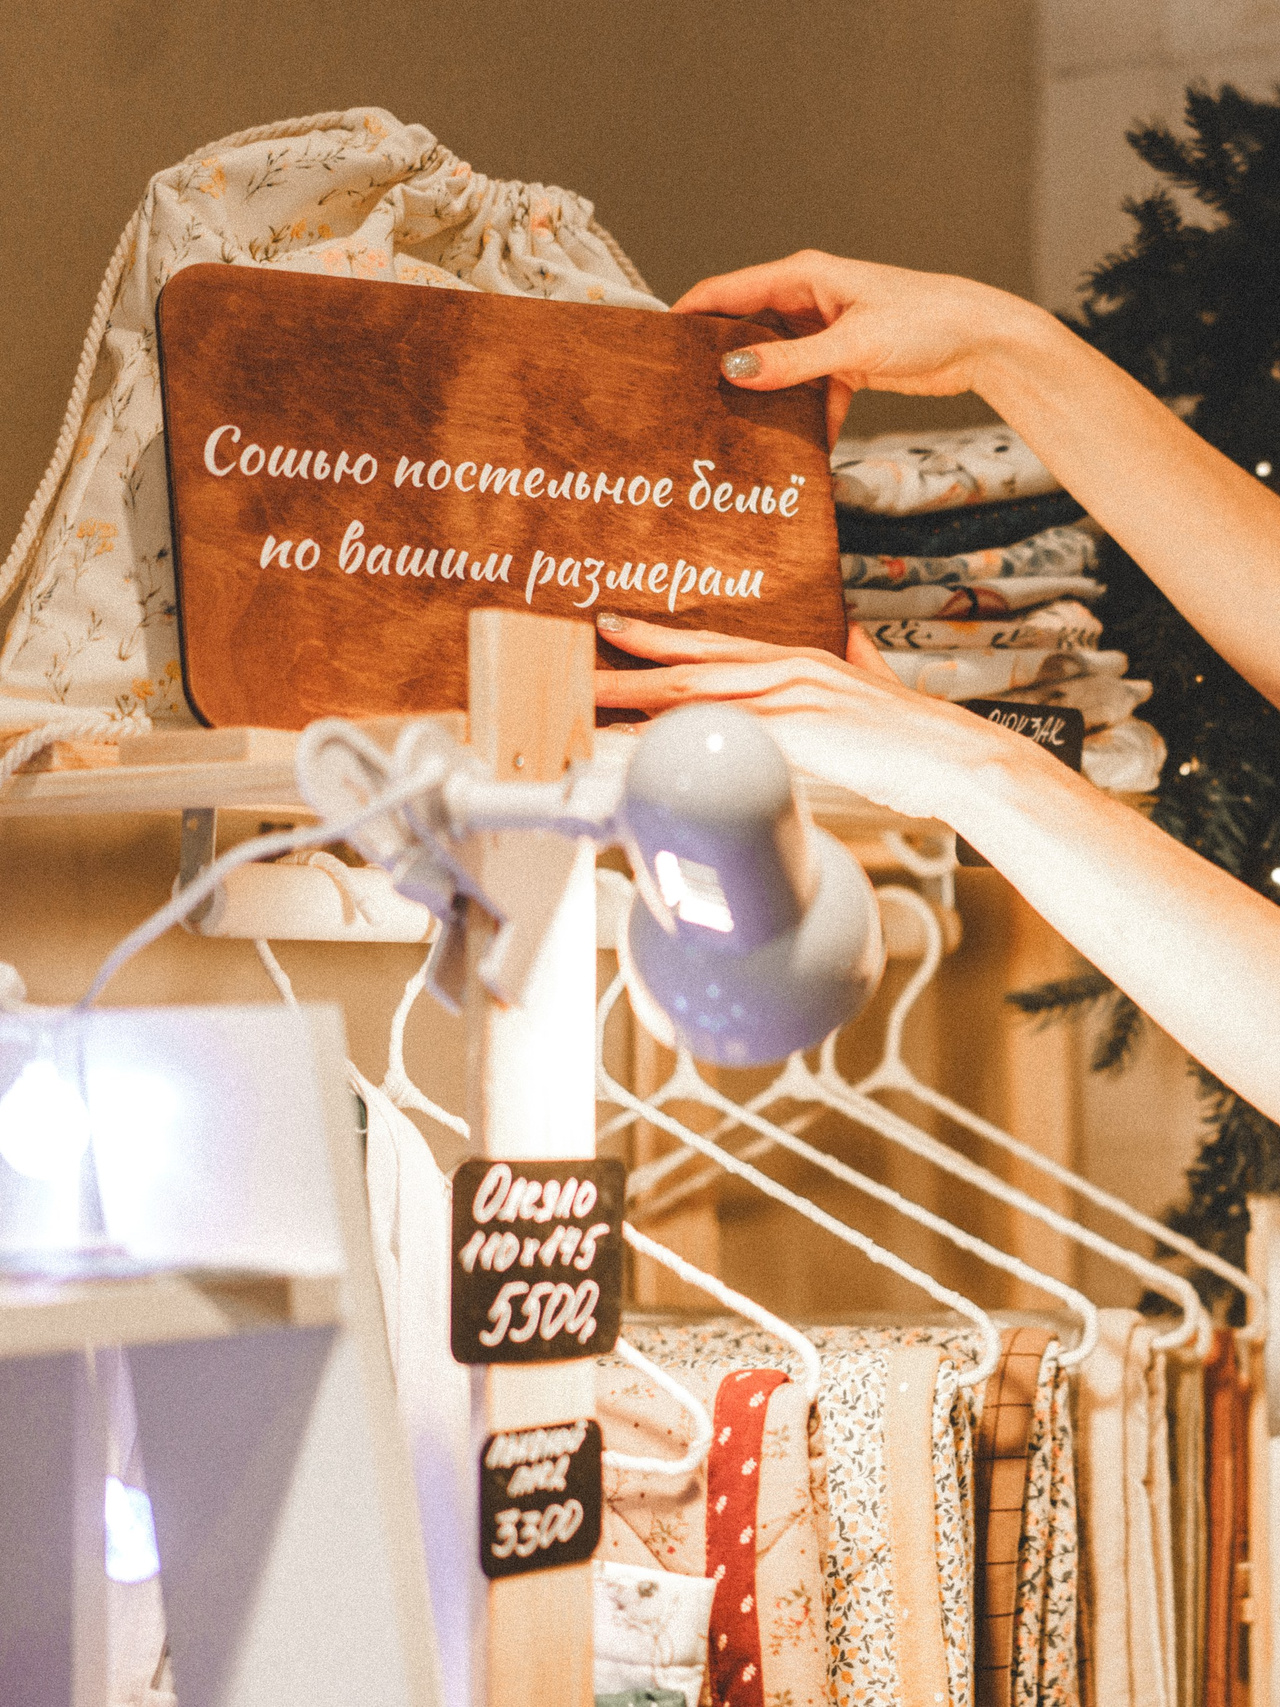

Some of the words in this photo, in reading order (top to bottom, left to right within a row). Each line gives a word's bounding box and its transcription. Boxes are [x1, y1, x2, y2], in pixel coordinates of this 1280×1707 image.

[203, 425, 379, 485] Сошью
[393, 456, 674, 509] постельное
[687, 459, 807, 519] бельё
[260, 534, 321, 572] по
[338, 520, 513, 583] вашим
[525, 550, 765, 612] размерам
[491, 1498, 585, 1559] 3300
